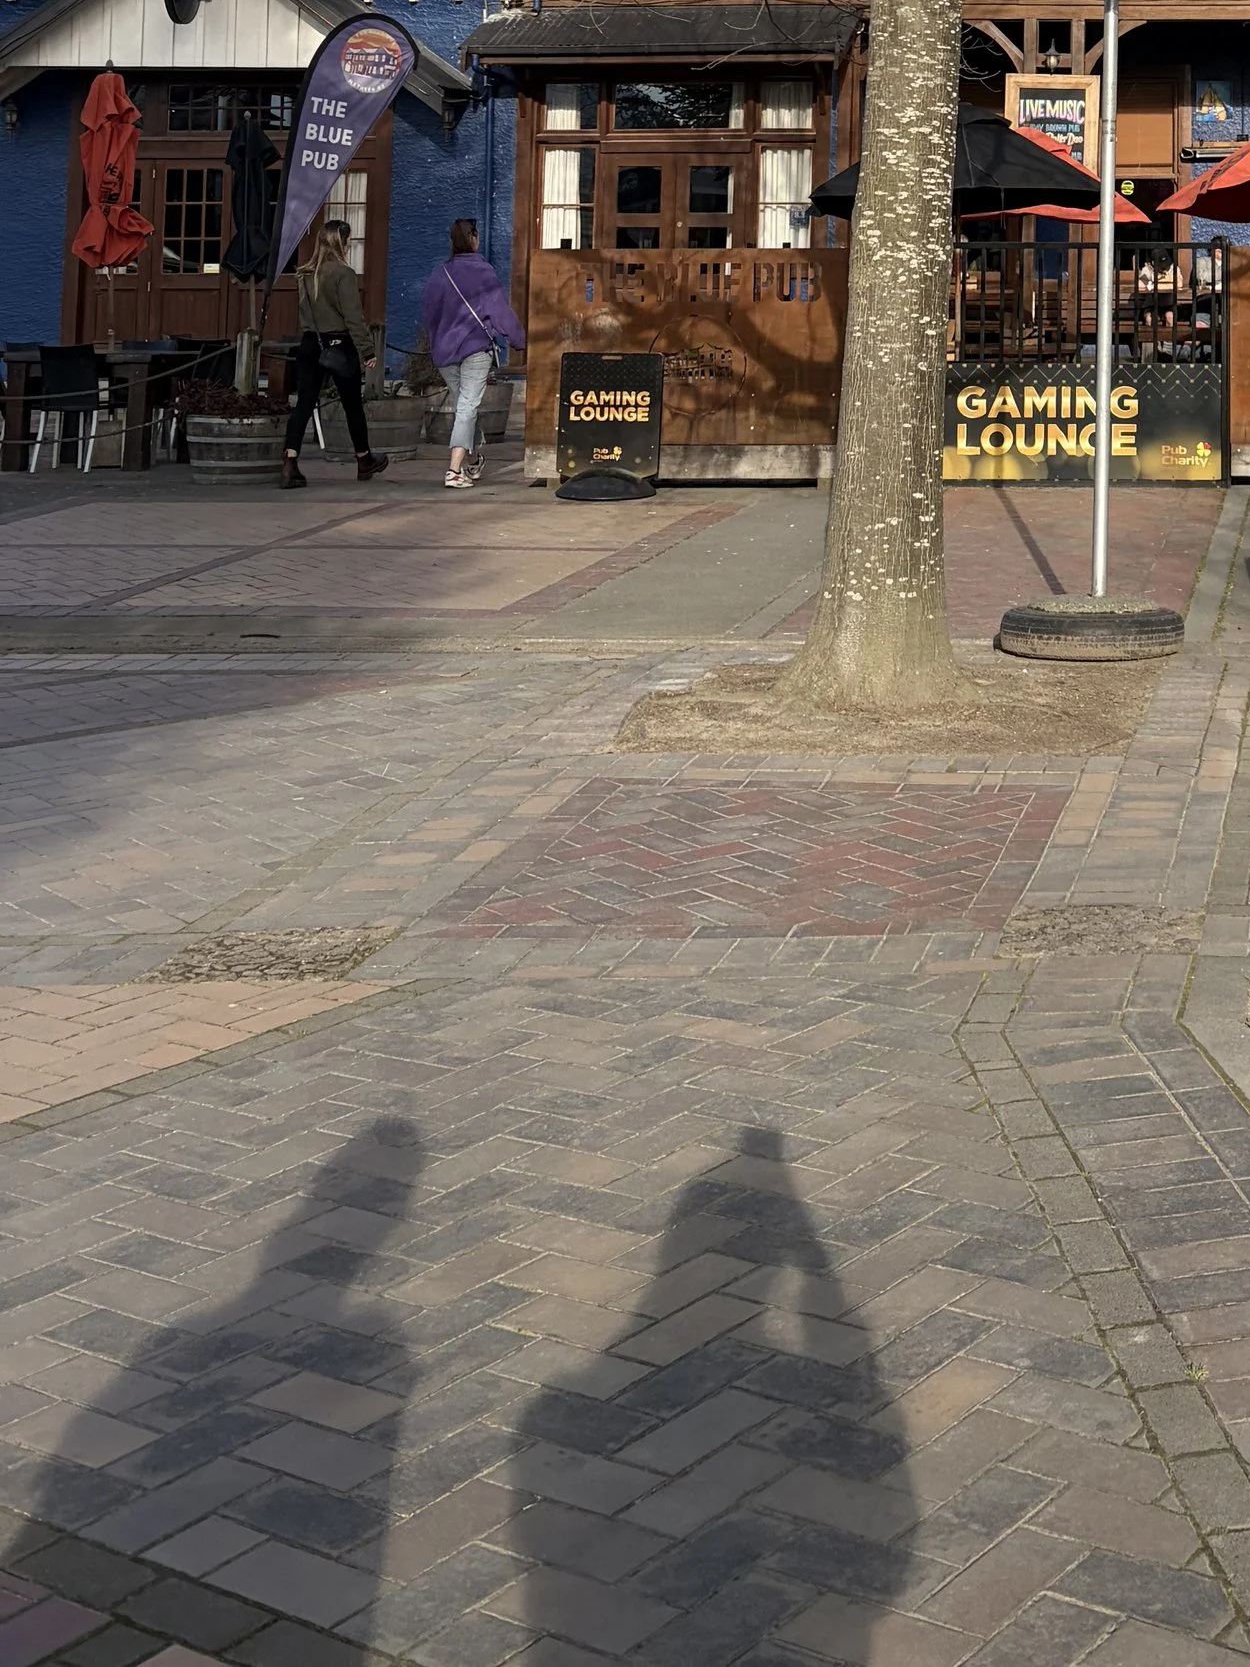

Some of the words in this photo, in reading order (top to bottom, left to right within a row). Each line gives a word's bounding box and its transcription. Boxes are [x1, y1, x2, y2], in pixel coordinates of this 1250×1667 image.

[310, 96, 348, 119] THE
[1019, 99, 1045, 124] LIVE
[1046, 99, 1086, 124] MUSIC
[305, 123, 353, 146] BLUE
[301, 149, 339, 170] PUB
[580, 263, 645, 302] THE
[656, 263, 742, 302] BLUE
[753, 263, 822, 302] PUB
[570, 390, 651, 406] GAMING
[957, 386, 1139, 419] GAMING
[569, 406, 650, 422] LOUNGE
[1161, 445, 1187, 455] Pub
[1161, 455, 1209, 468] Charity
